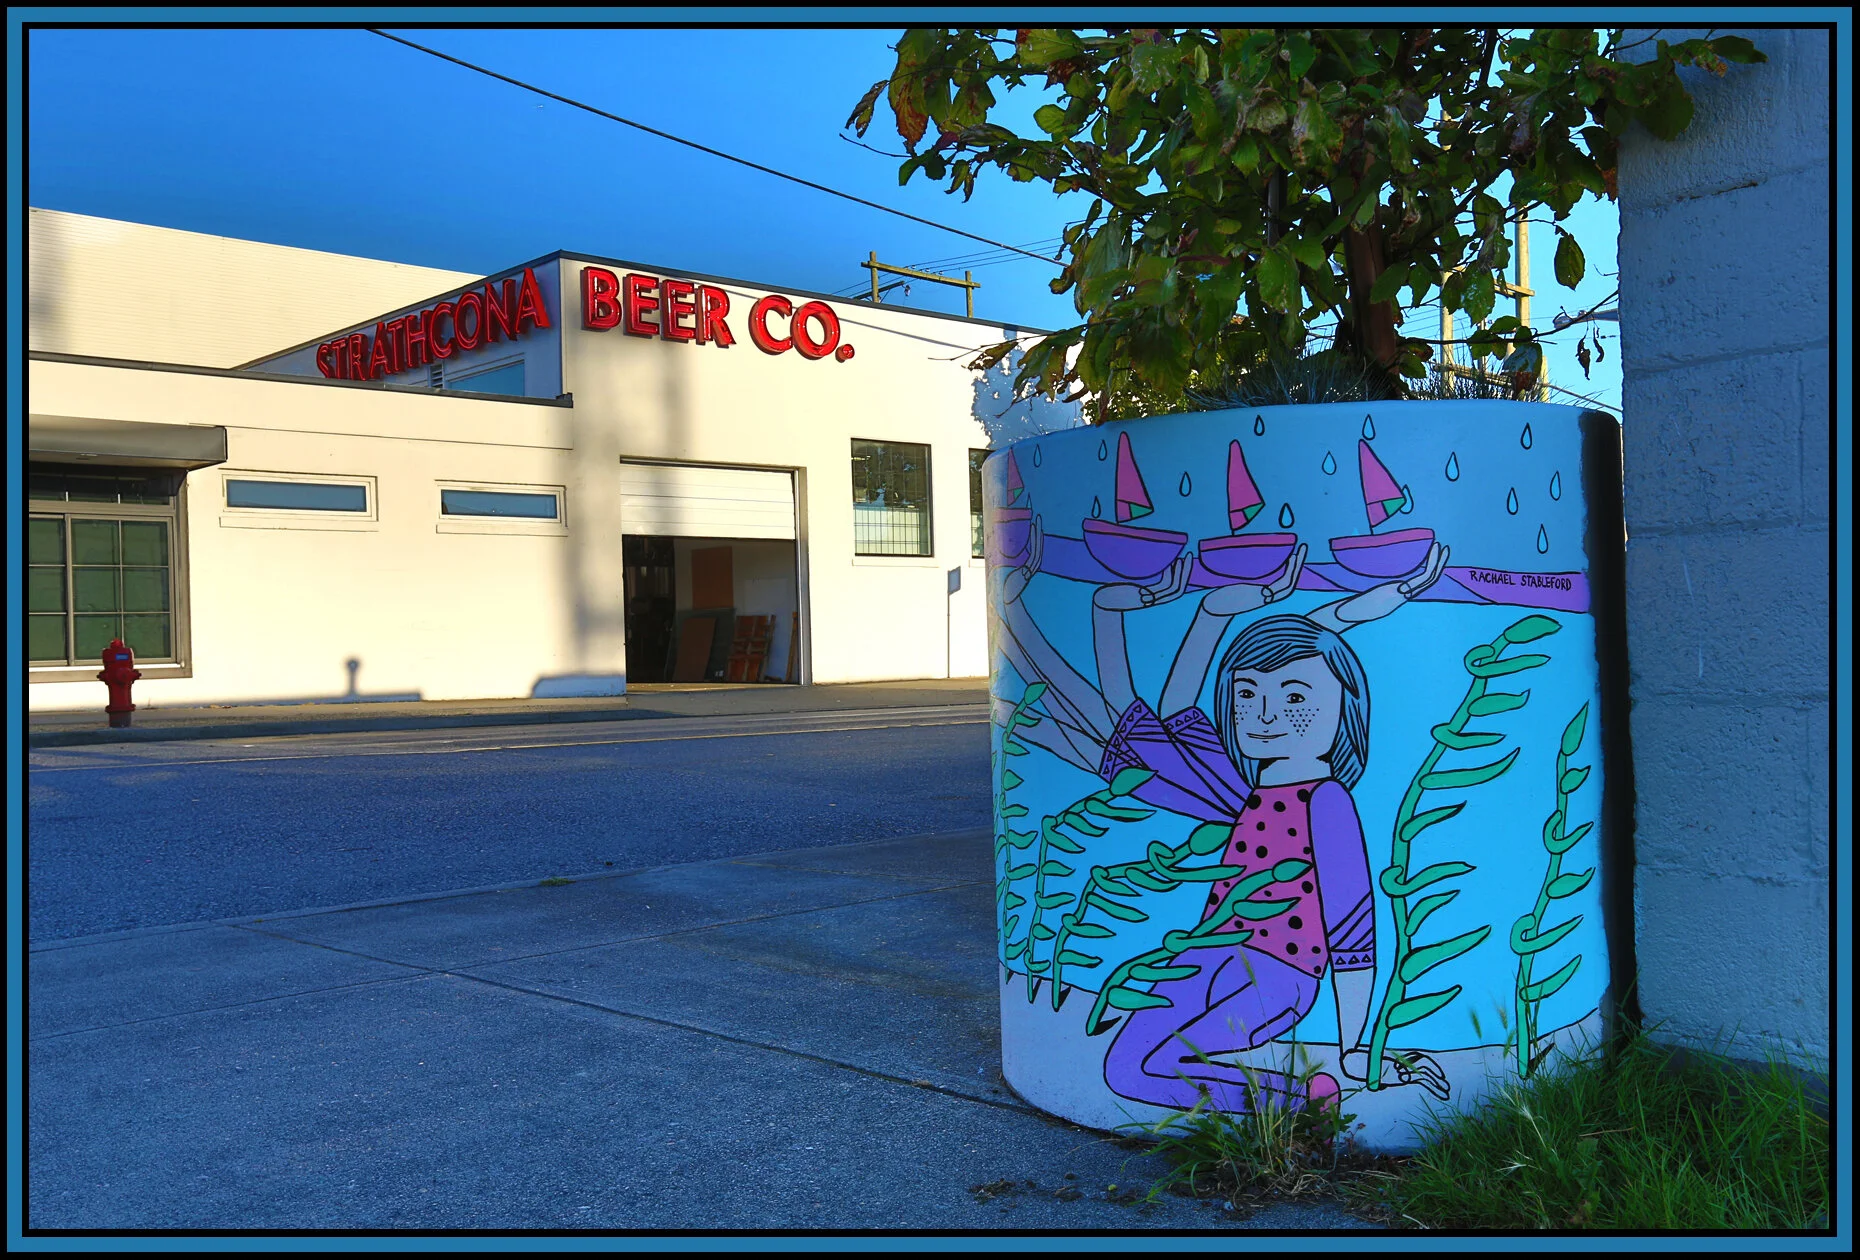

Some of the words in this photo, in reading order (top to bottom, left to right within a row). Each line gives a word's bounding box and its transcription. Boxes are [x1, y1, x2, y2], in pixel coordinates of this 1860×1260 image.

[316, 267, 550, 380] STRATHCONA
[581, 265, 736, 348] BEER
[748, 294, 855, 361] CO.
[1469, 570, 1516, 586] RACHAEL
[1520, 574, 1572, 591] STABLEFORD
